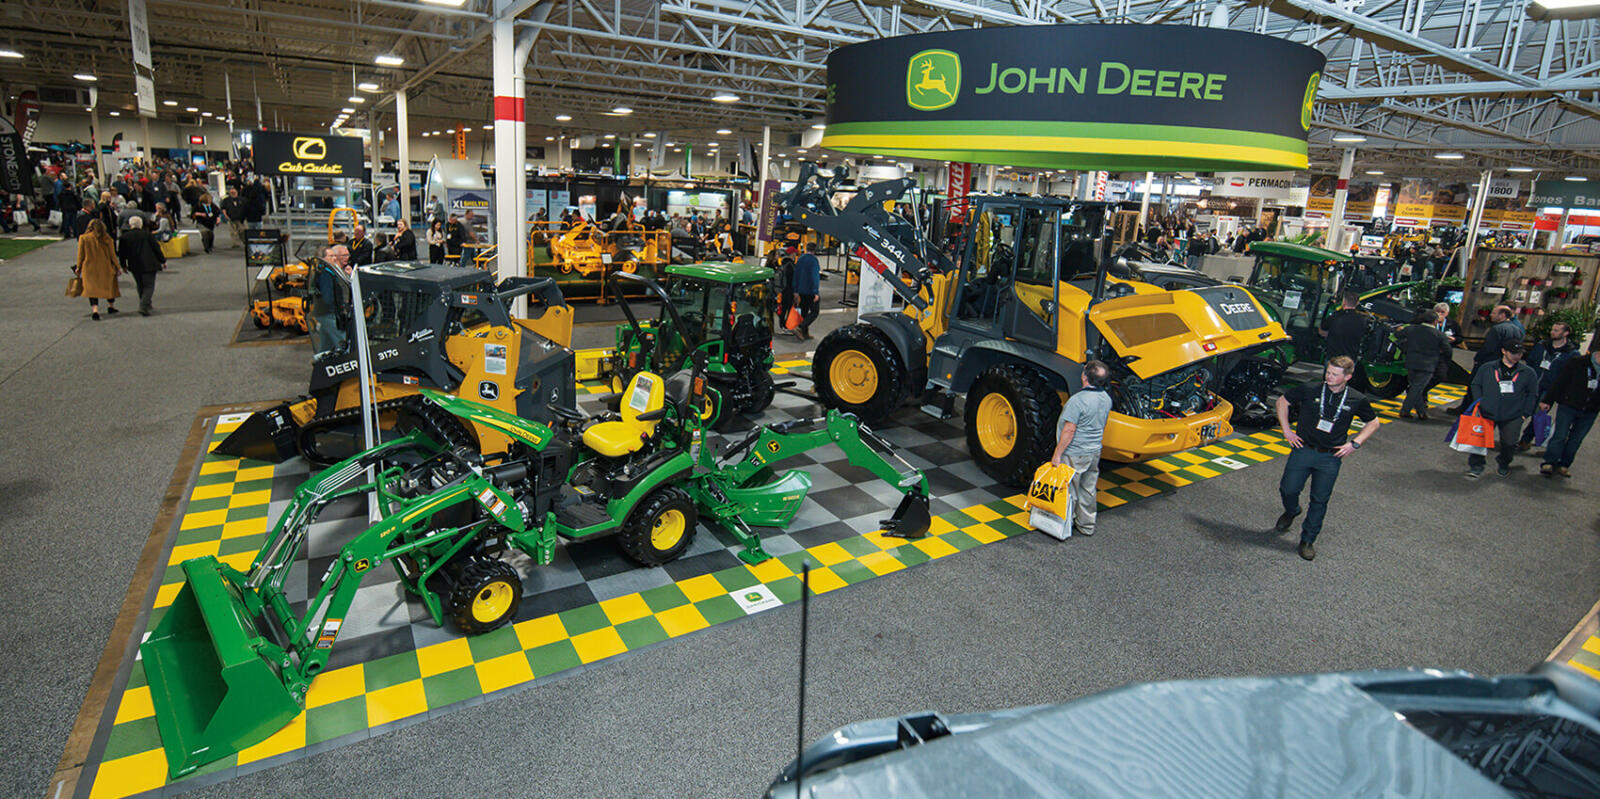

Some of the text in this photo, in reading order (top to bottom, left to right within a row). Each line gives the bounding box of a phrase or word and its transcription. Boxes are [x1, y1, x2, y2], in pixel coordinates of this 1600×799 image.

[975, 61, 1227, 100] JOHN DEERE
[278, 162, 342, 174] Cub Cadet
[1490, 186, 1512, 195] 1800
[880, 238, 906, 264] 344L
[1220, 303, 1255, 315] DEERE
[325, 349, 399, 377] DEER 317G
[1031, 481, 1059, 503] CAT
